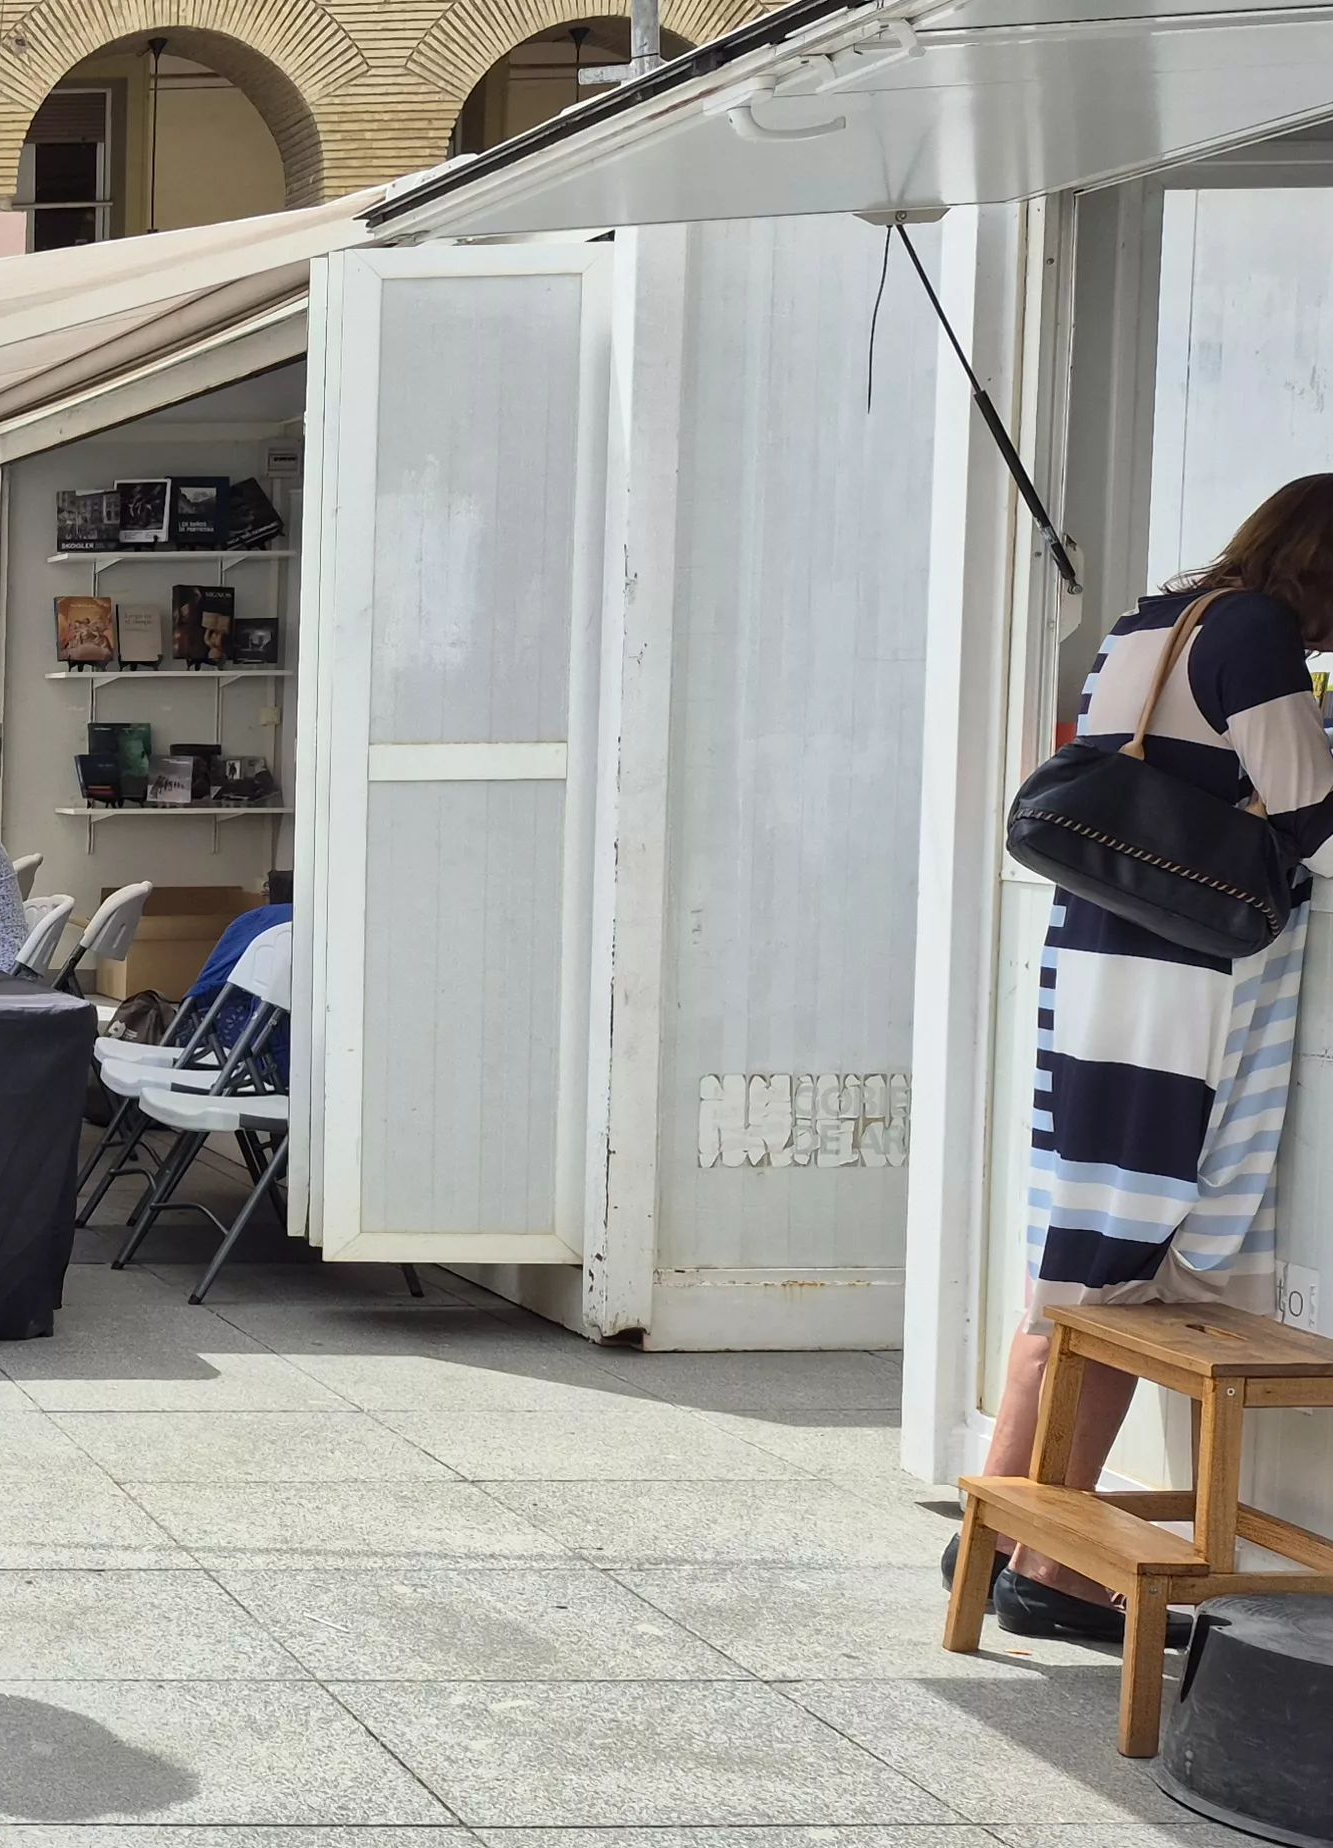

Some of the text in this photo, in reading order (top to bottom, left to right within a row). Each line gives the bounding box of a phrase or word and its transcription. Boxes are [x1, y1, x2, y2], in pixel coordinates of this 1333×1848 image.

[794, 1085, 908, 1117] GOBIE
[854, 1123, 908, 1155] AR
[1277, 1278, 1304, 1318] to
